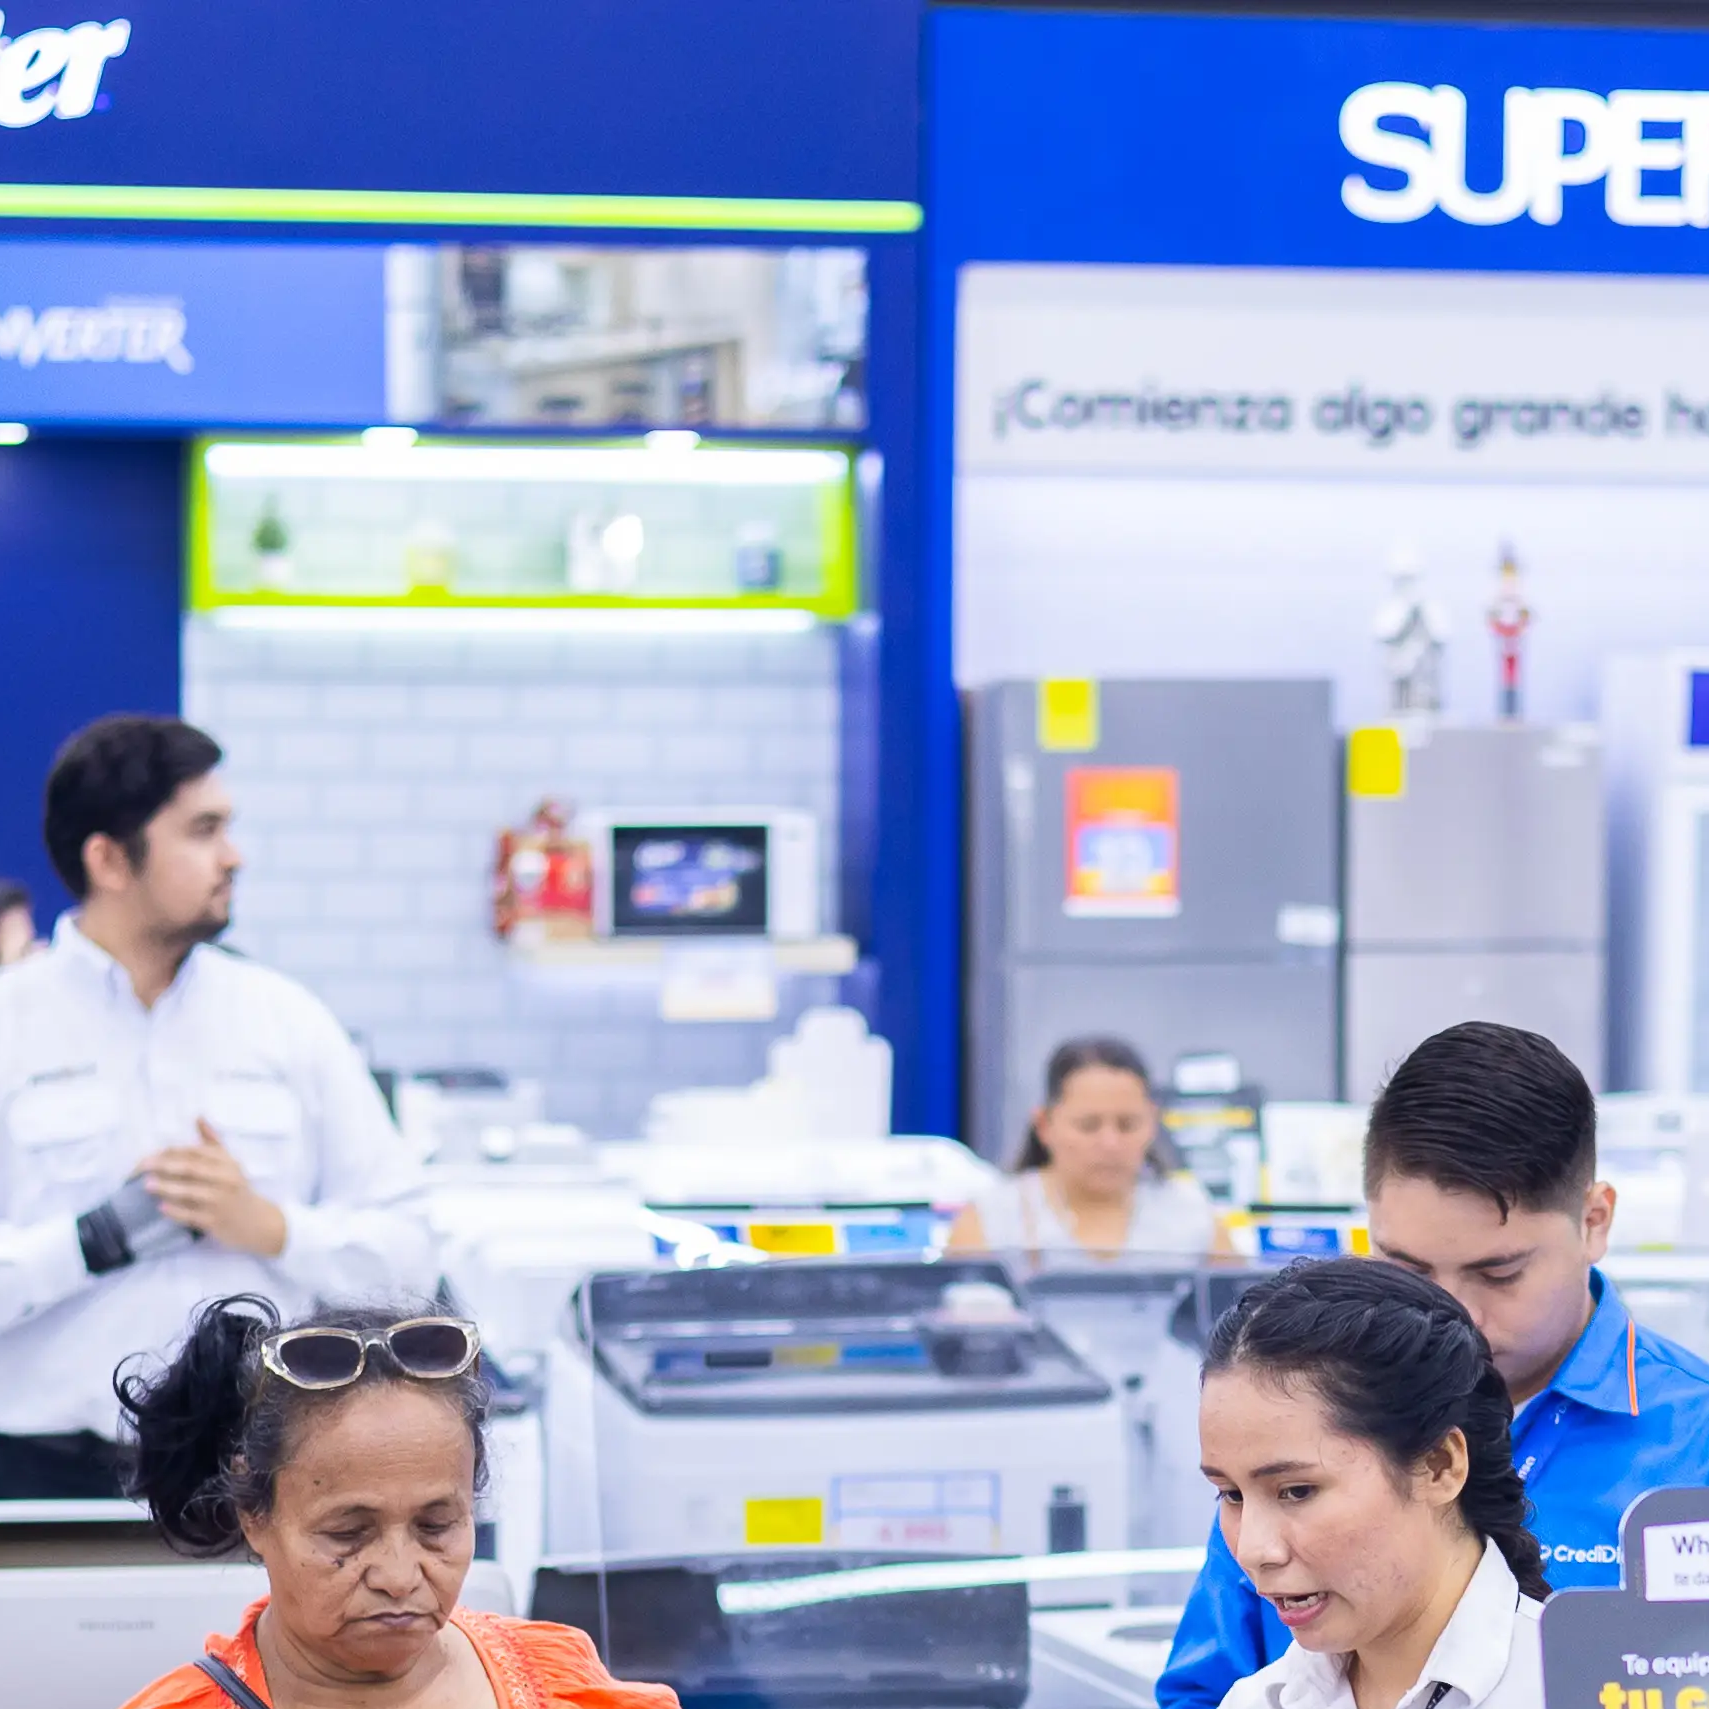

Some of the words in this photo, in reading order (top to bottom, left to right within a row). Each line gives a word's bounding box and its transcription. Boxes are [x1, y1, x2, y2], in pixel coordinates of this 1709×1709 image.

[1311, 384, 1435, 449] algo
[1453, 388, 1648, 451] grande
[1622, 1653, 1648, 1676] Te
